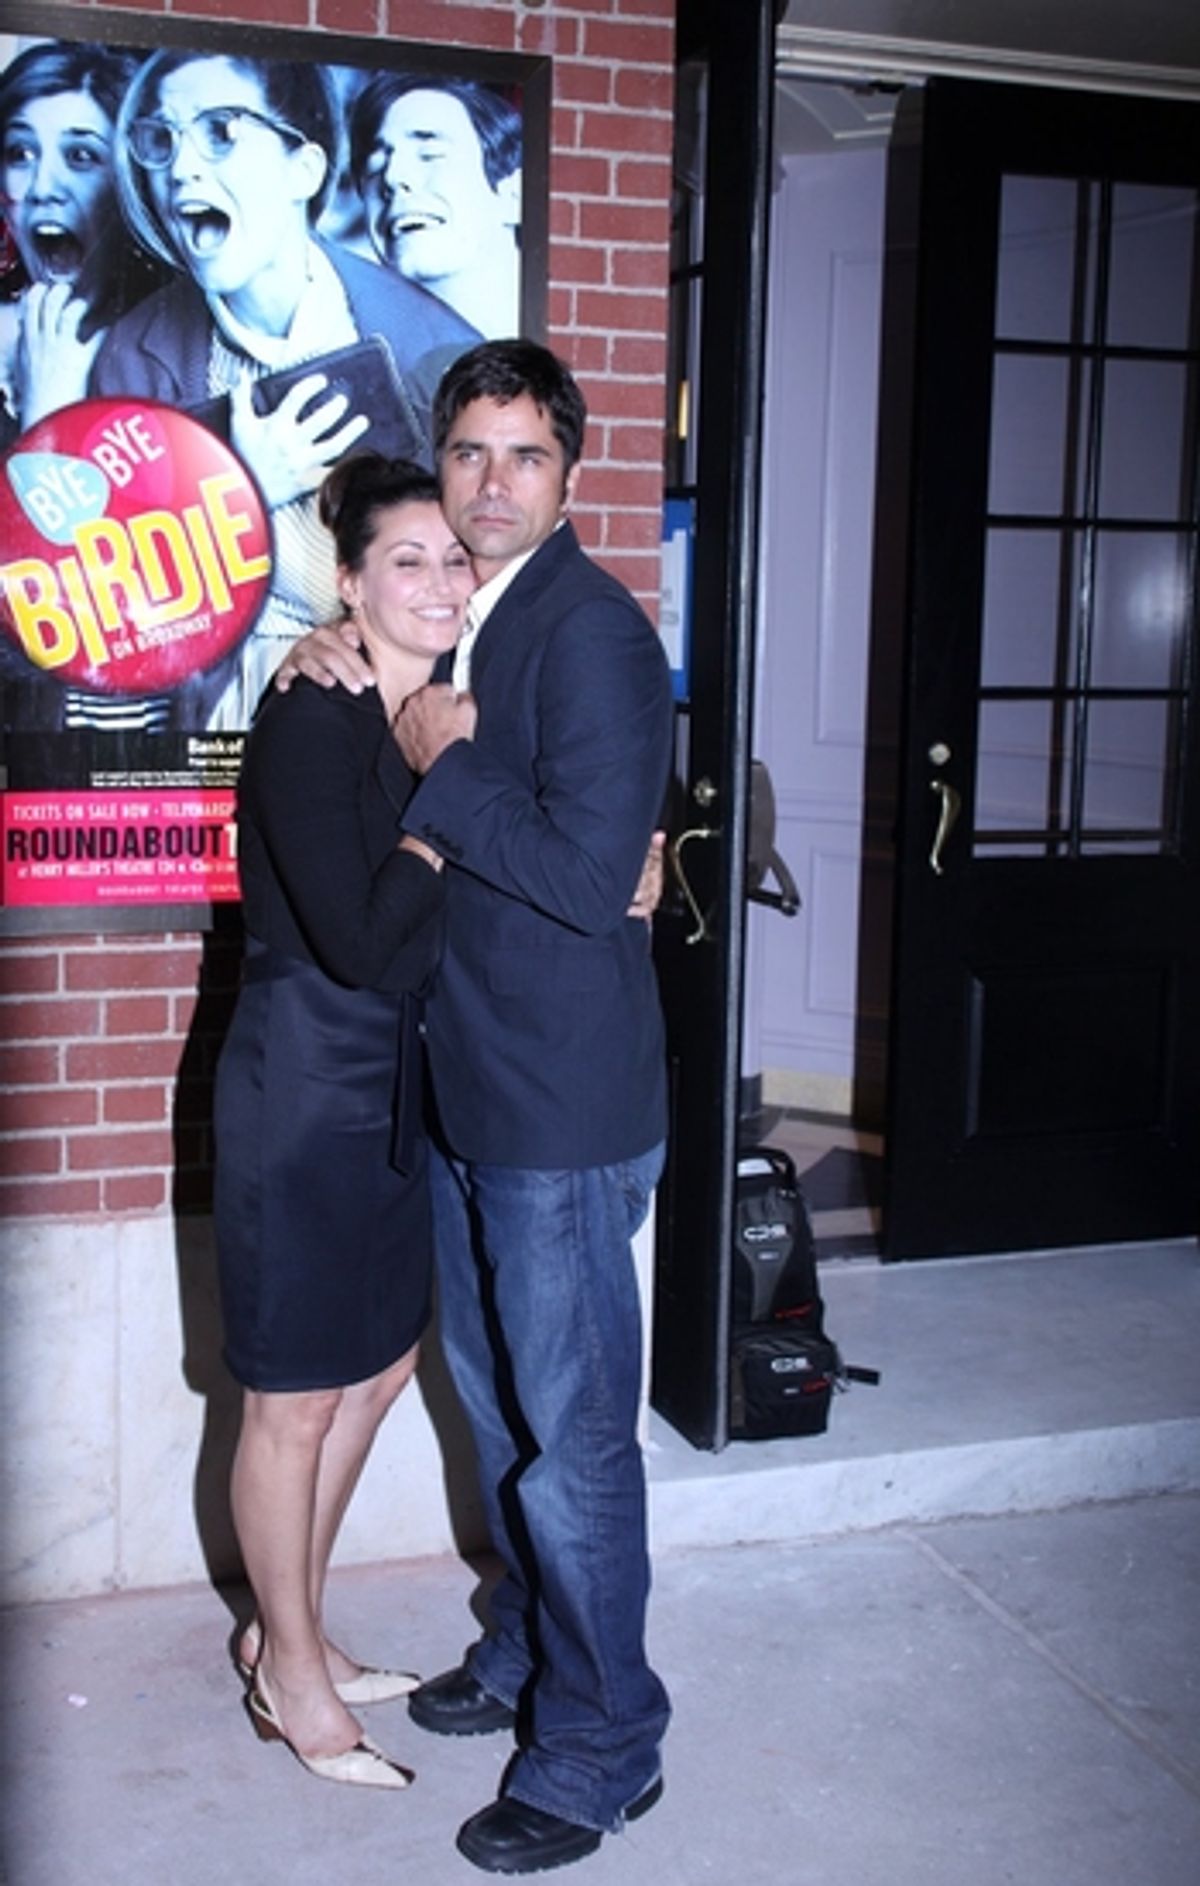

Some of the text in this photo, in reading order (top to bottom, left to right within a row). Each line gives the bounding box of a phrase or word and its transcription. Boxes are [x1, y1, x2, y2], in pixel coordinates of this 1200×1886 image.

[92, 415, 166, 489] BYE
[26, 462, 98, 532] BYE
[0, 472, 271, 670] BIRDIE
[7, 824, 224, 862] ROUNDABOUT
[13, 804, 62, 821] TICKETS
[65, 803, 84, 821] ON
[88, 802, 118, 821] SALE
[121, 802, 150, 819] NOW
